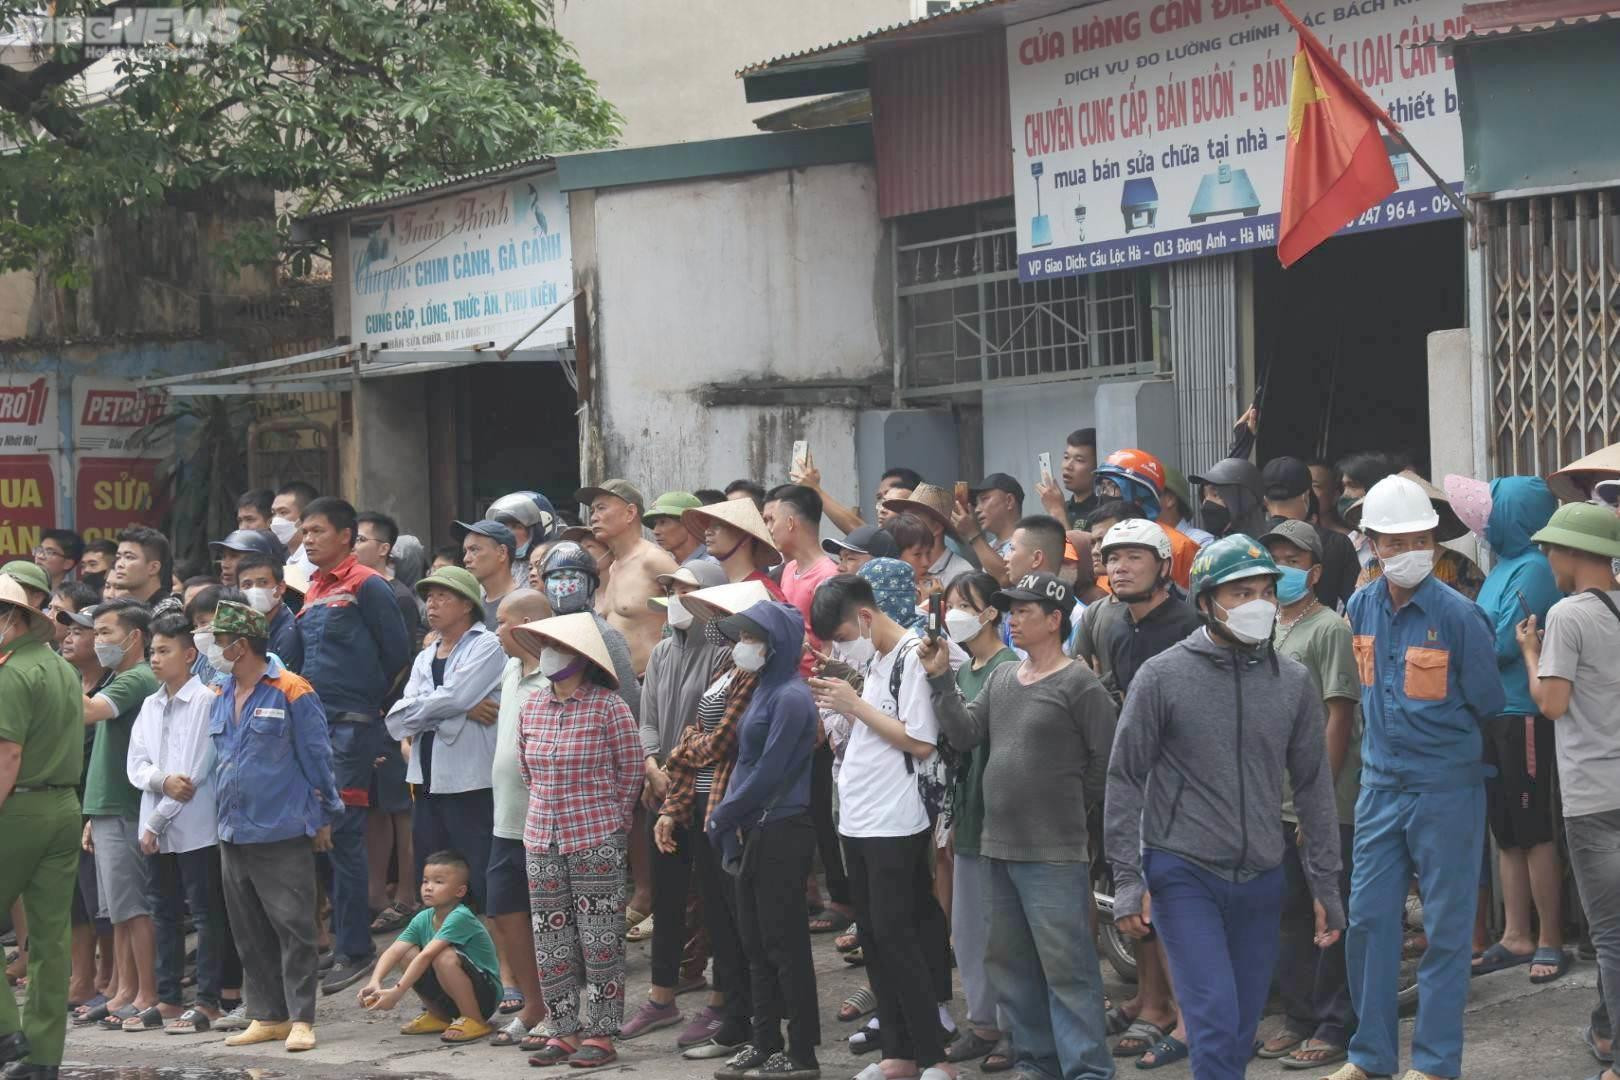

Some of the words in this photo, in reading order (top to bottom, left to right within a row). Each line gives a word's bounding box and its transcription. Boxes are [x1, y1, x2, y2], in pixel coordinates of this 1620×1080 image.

[1019, 27, 1065, 66] CỬA
[1072, 12, 1141, 54] HÀNG
[1064, 66, 1100, 87] DỊCH
[1106, 58, 1129, 78] VỤ
[1136, 51, 1160, 69] ĐO
[1229, 22, 1280, 46] CHÍNH
[1288, 10, 1327, 34] ÁC
[1332, 0, 1386, 22] BÁCH
[1024, 97, 1074, 158] CHUYÊN
[1078, 97, 1115, 147] CUNG
[1155, 72, 1188, 131] BÁN
[1191, 62, 1235, 126] BUÔN
[1253, 48, 1288, 112] BÁN
[1053, 168, 1087, 189] mua
[1092, 158, 1120, 182] bán
[1127, 149, 1155, 176] sửa
[1161, 144, 1200, 169] chữa
[1207, 133, 1230, 164] tại
[1236, 127, 1268, 155] nhà
[1387, 90, 1436, 123] thiết
[415, 256, 449, 287] CHIM
[499, 238, 518, 272] GÀ
[1028, 259, 1042, 276] VP
[1045, 256, 1063, 274] Giao
[1128, 243, 1142, 263] Hà
[1153, 239, 1174, 258] QL3
[1206, 231, 1227, 250] Anh
[1240, 226, 1254, 245] Hà
[1257, 223, 1275, 245] Nội
[1386, 200, 1416, 221] 964
[365, 313, 392, 334] CUNG
